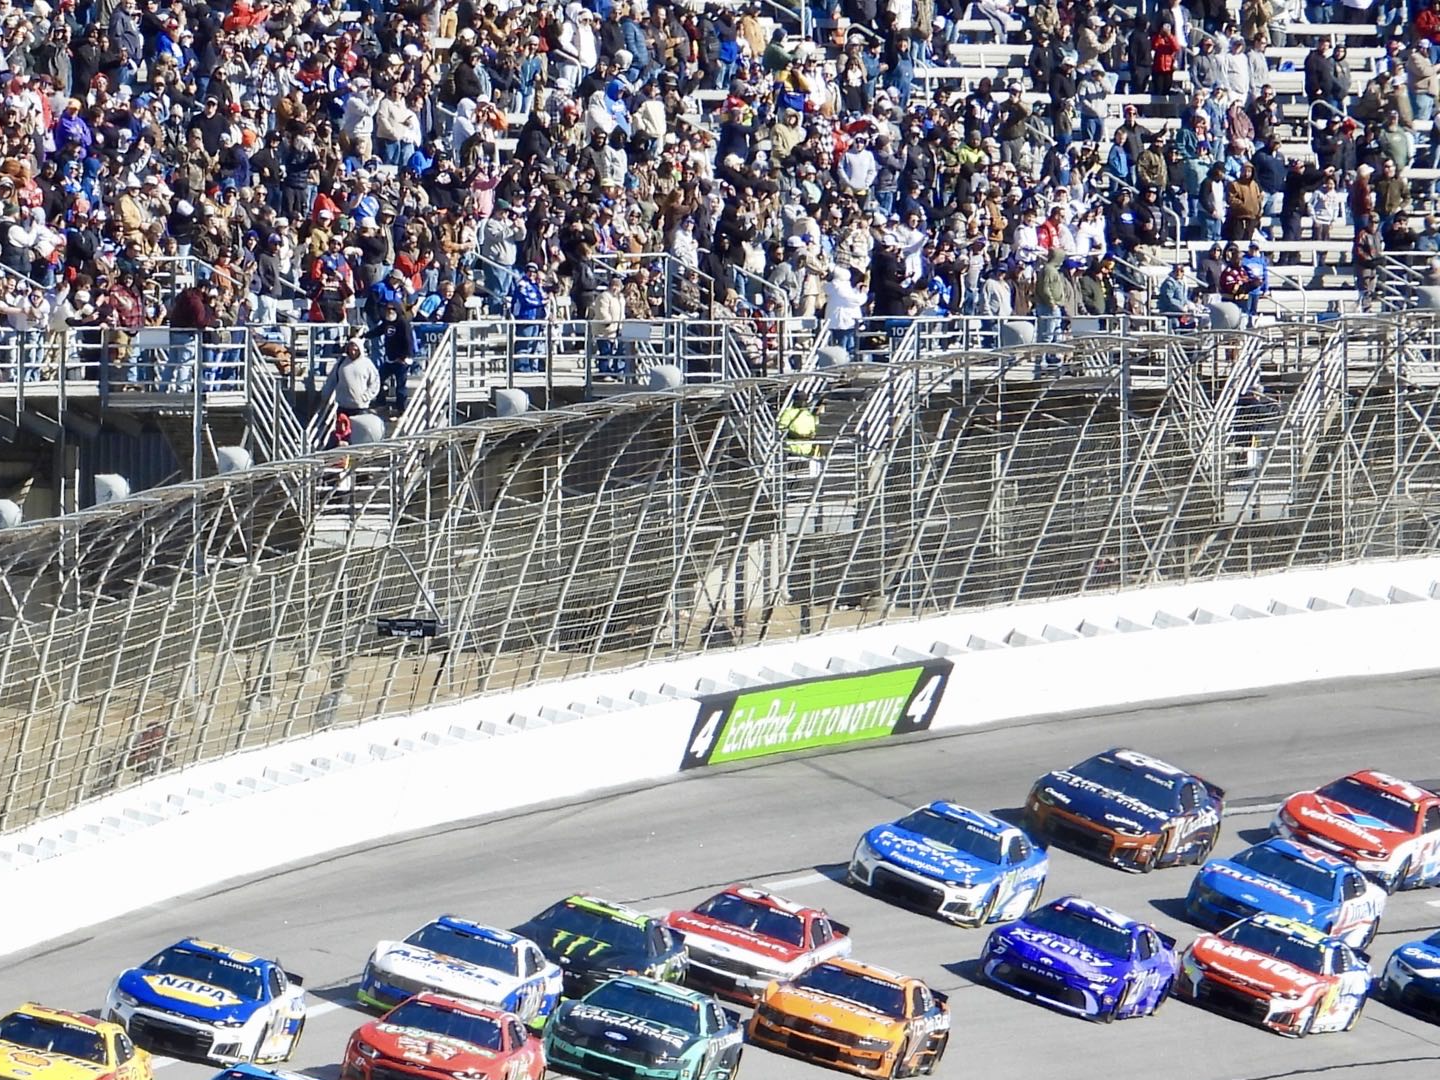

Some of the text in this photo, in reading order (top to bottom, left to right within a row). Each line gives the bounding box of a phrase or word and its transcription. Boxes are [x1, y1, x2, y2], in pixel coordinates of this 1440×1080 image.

[689, 674, 944, 758] 4 EchoPark AUTOMOTIVE 4
[1300, 806, 1383, 845] Valvoline
[879, 831, 983, 873] Freeway
[889, 850, 945, 876] Freeway.com
[678, 916, 789, 955] Motorcraft
[1010, 927, 1113, 967] xfinity
[218, 959, 254, 973] ELLIOTT
[158, 974, 226, 1002] NAPA
[569, 1010, 684, 1049] SUBMARINES
